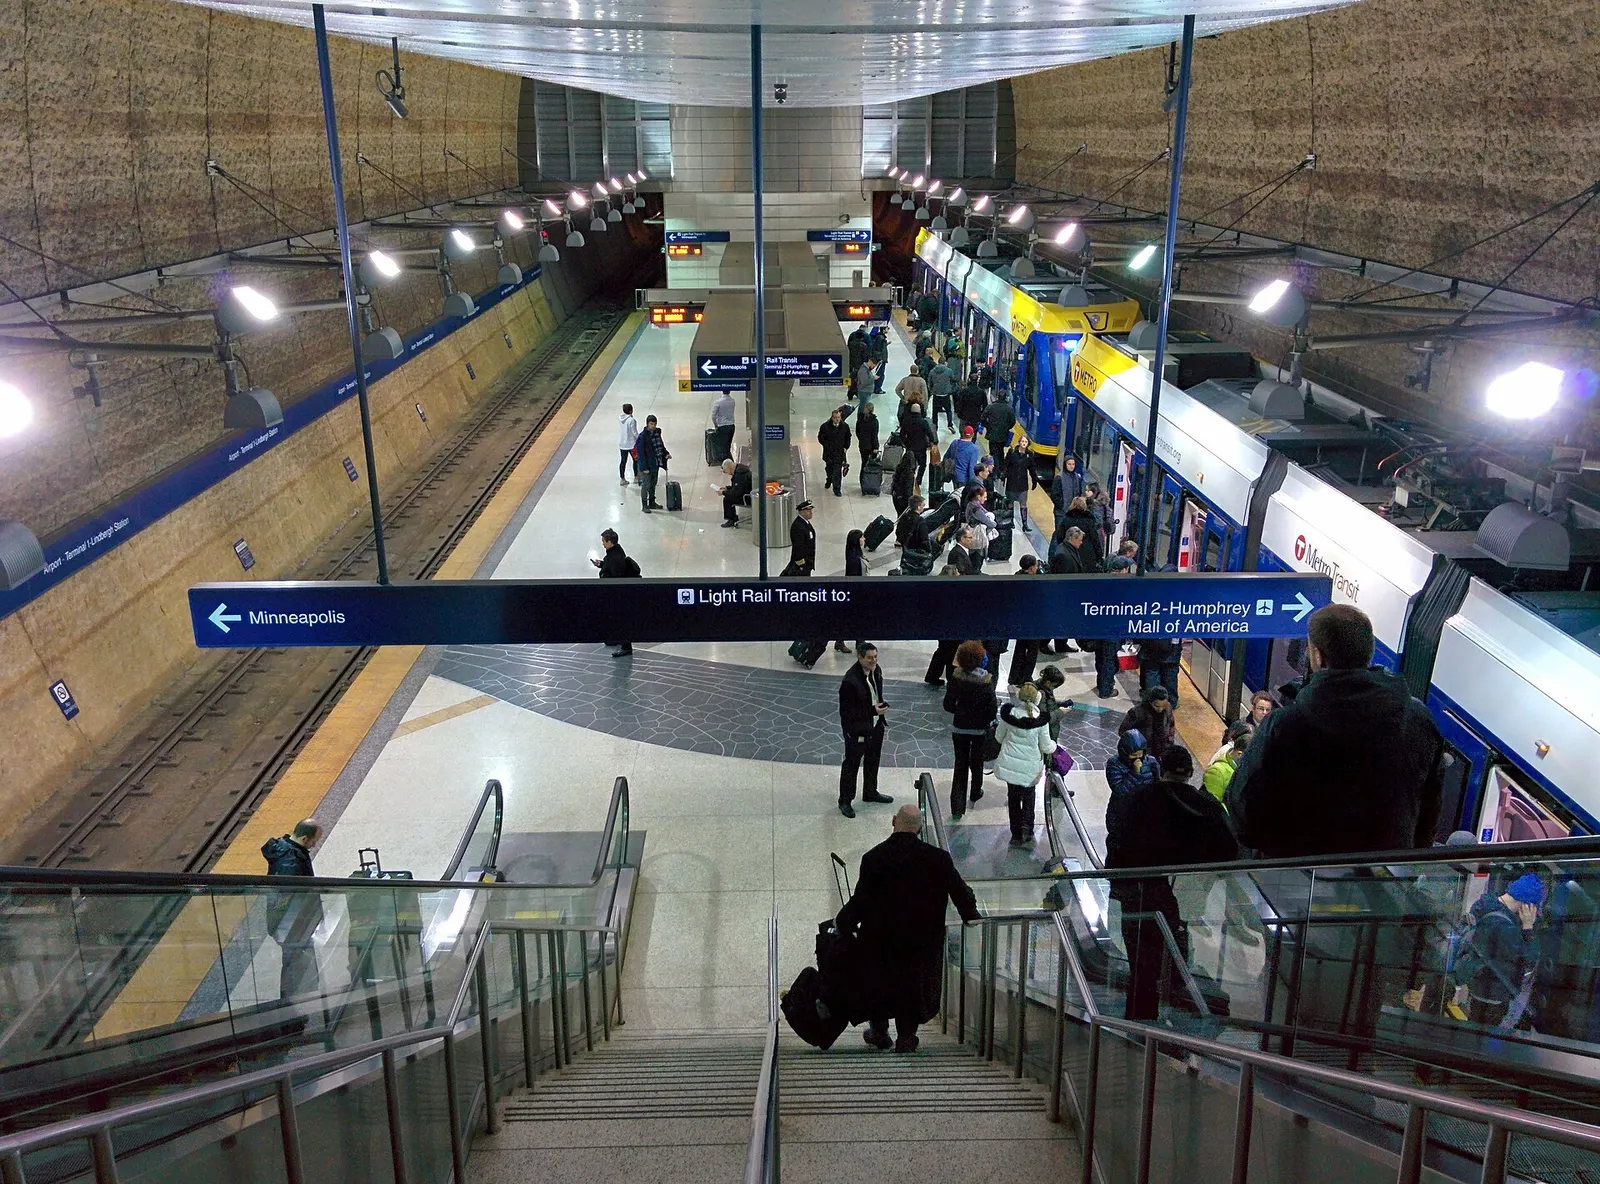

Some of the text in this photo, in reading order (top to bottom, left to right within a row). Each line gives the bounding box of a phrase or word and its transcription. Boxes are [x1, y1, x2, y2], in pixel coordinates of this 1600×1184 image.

[1081, 369, 1097, 392] METRO
[43, 557, 62, 575] Airport
[65, 541, 87, 561] Terminal
[87, 526, 114, 548] 1-Lindbergh
[114, 518, 130, 532] Station
[1305, 544, 1331, 576] Metro
[1333, 562, 1360, 603] Transit
[699, 588, 850, 606] Light Rail Transit to:
[249, 610, 346, 627] Minneapolis
[1081, 601, 1251, 618] Terminal 2-Humphrey
[1128, 619, 1249, 633] Mall of America
